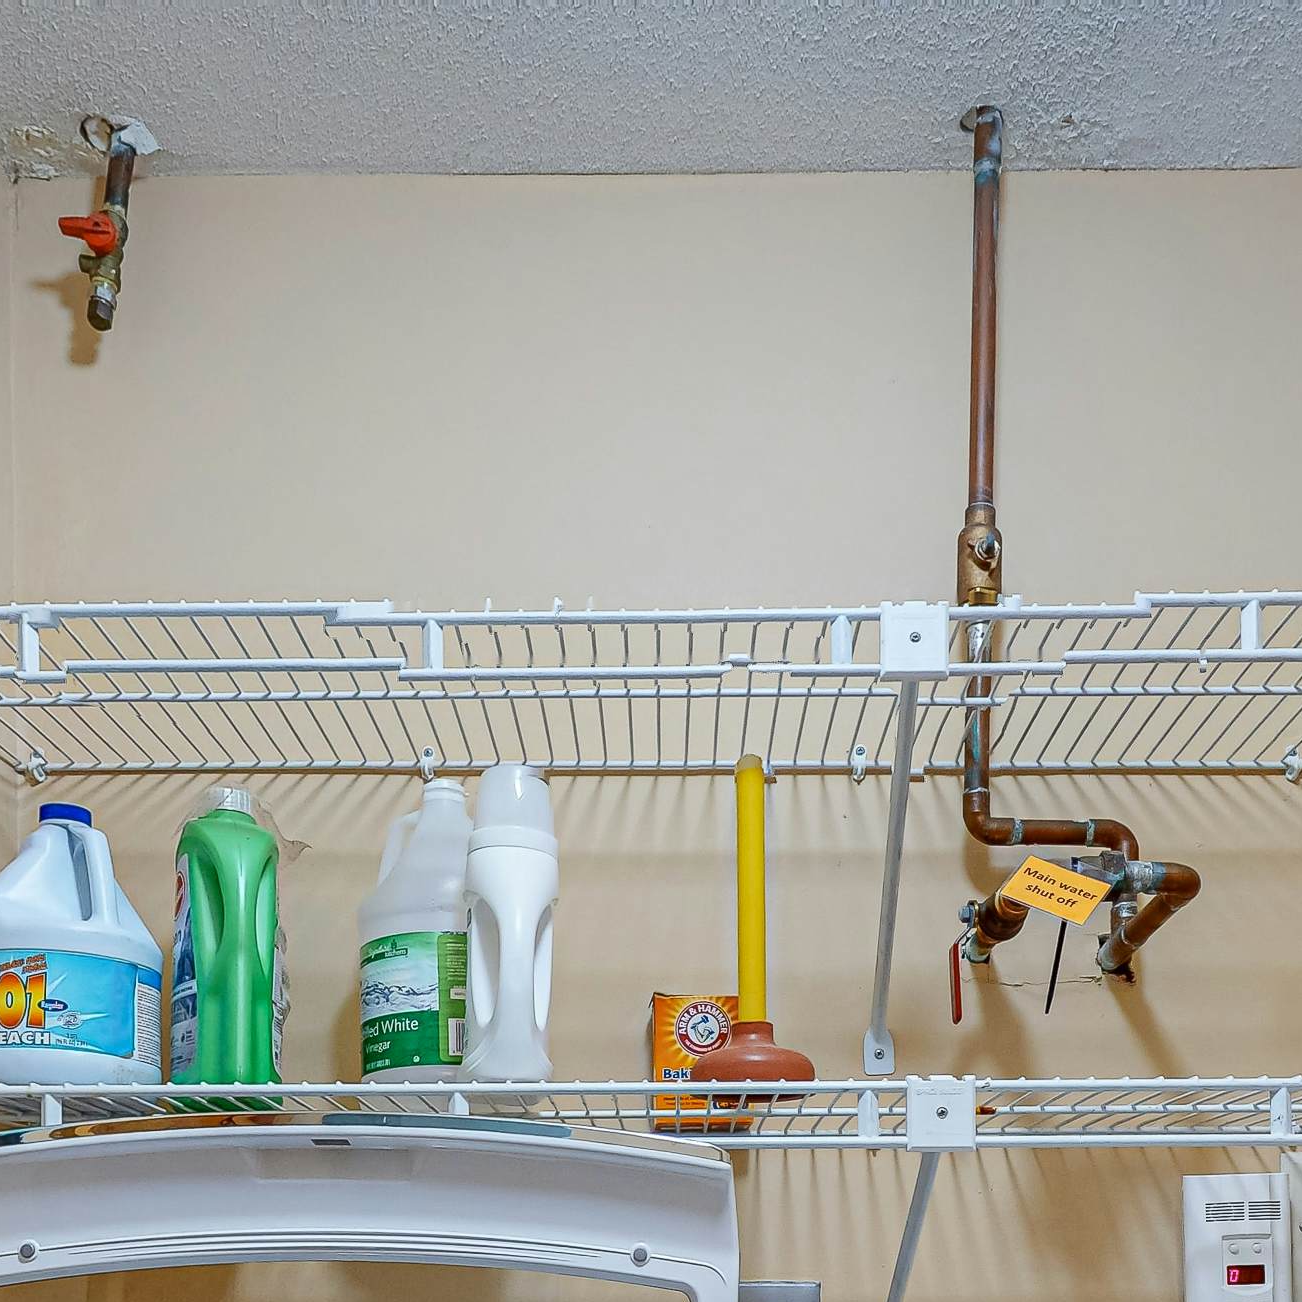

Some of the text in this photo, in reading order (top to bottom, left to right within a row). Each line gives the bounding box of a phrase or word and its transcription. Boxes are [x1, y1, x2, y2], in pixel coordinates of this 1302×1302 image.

[1023, 867, 1098, 900] Main water
[1025, 883, 1078, 908] shut off
[381, 1018, 419, 1034] White
[678, 1004, 728, 1035] ARM & HAMMER
